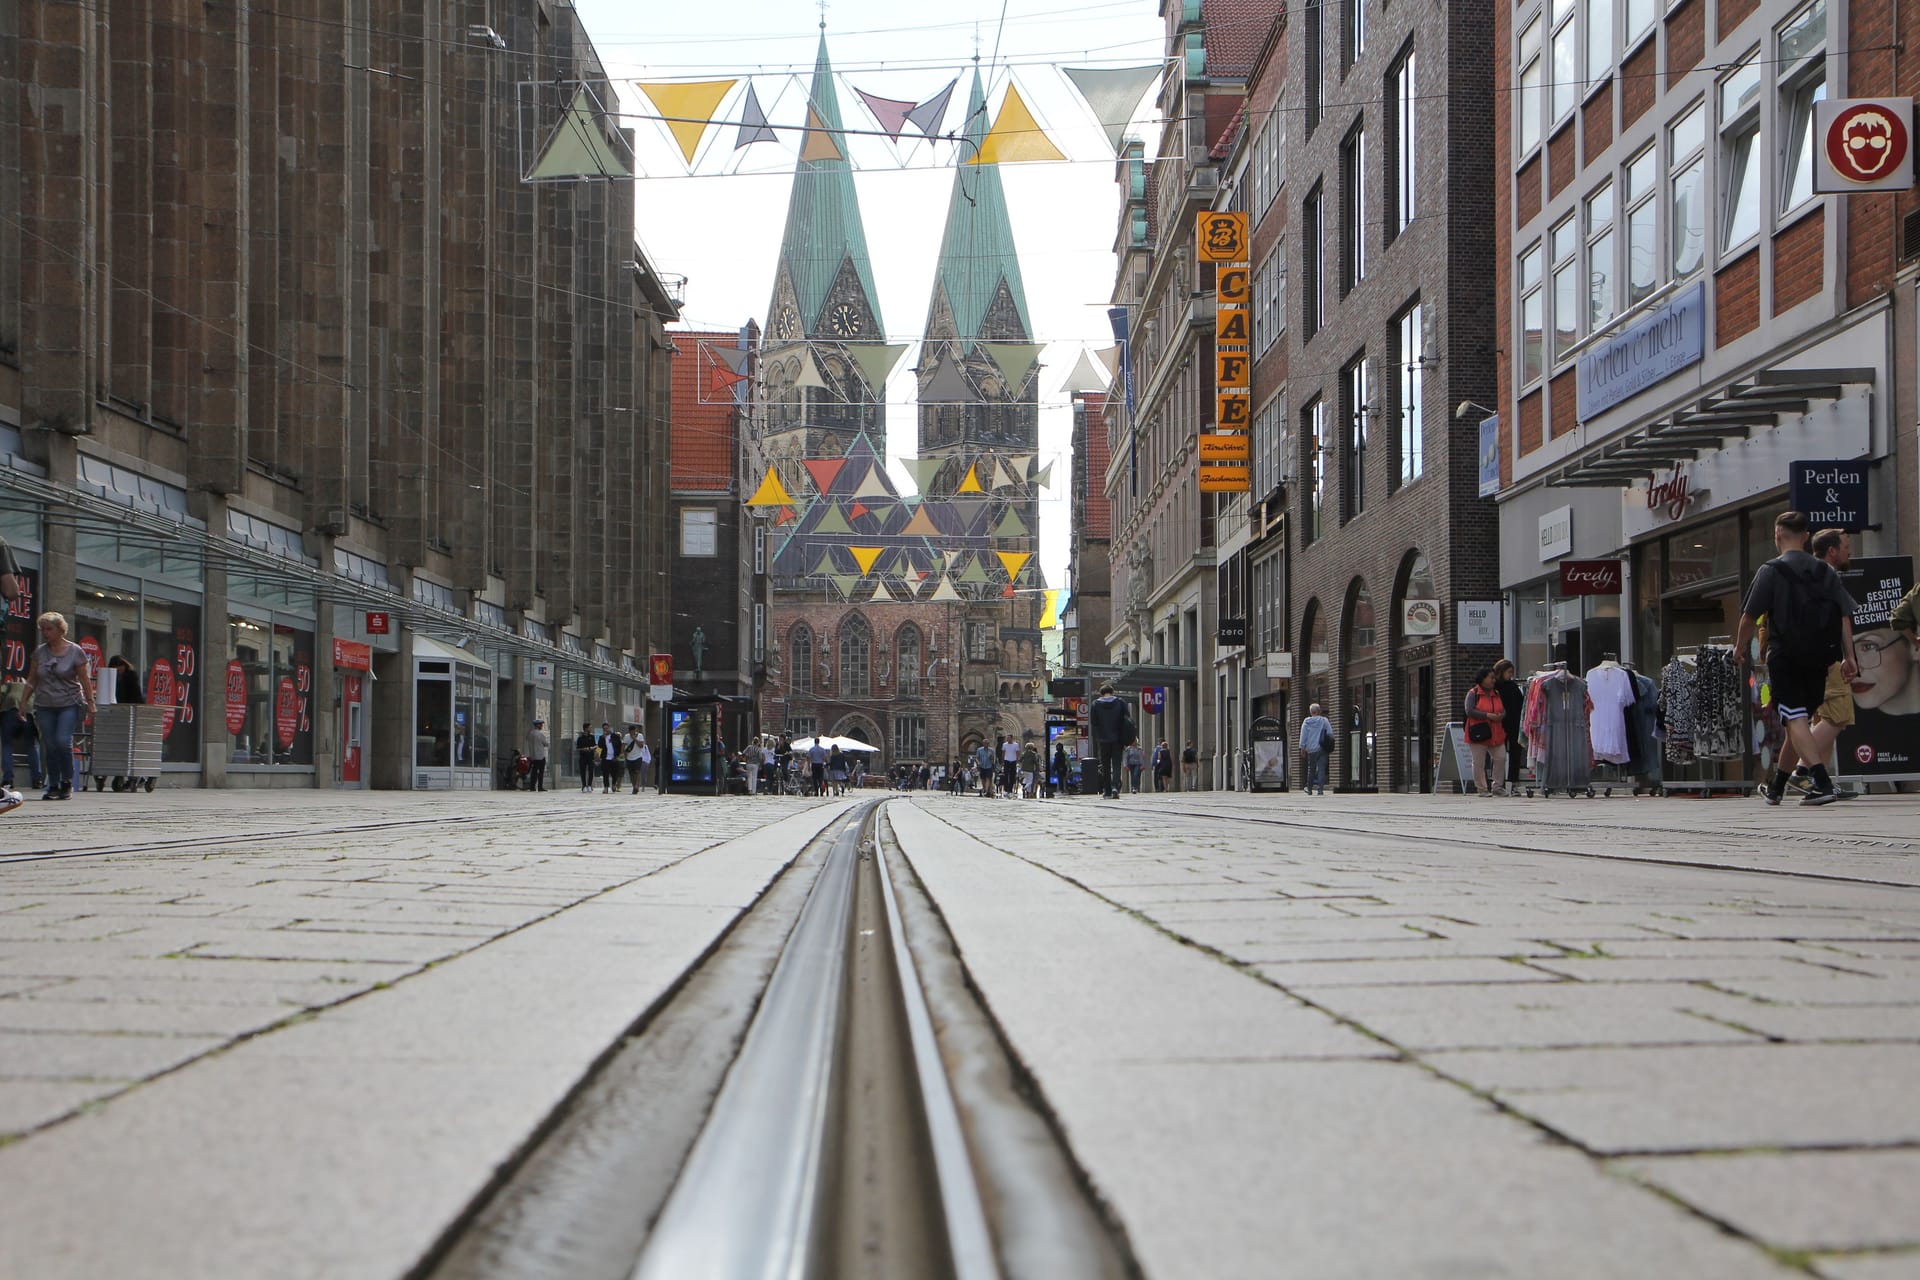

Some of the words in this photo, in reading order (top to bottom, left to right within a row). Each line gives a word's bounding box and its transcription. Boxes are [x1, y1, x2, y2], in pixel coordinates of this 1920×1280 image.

[1220, 271, 1246, 424] CAFÉ
[1588, 344, 1629, 394] Perlen
[1647, 304, 1687, 360] mehr
[1804, 468, 1860, 485] Perlen
[1647, 462, 1692, 520] tredy
[1825, 488, 1840, 503] &
[1809, 506, 1857, 522] mehr
[1567, 566, 1617, 589] tredy
[1880, 577, 1901, 589] DEIN
[1866, 588, 1902, 601] GESICHT
[8, 598, 31, 619] ALE
[1469, 610, 1487, 618] HELLO
[1854, 611, 1890, 625] GESCHIC
[1221, 628, 1244, 636] zero
[6, 639, 25, 671] 70
[176, 643, 195, 677] 50
[297, 664, 310, 692] 50
[177, 681, 194, 724] %
[297, 695, 310, 732] %
